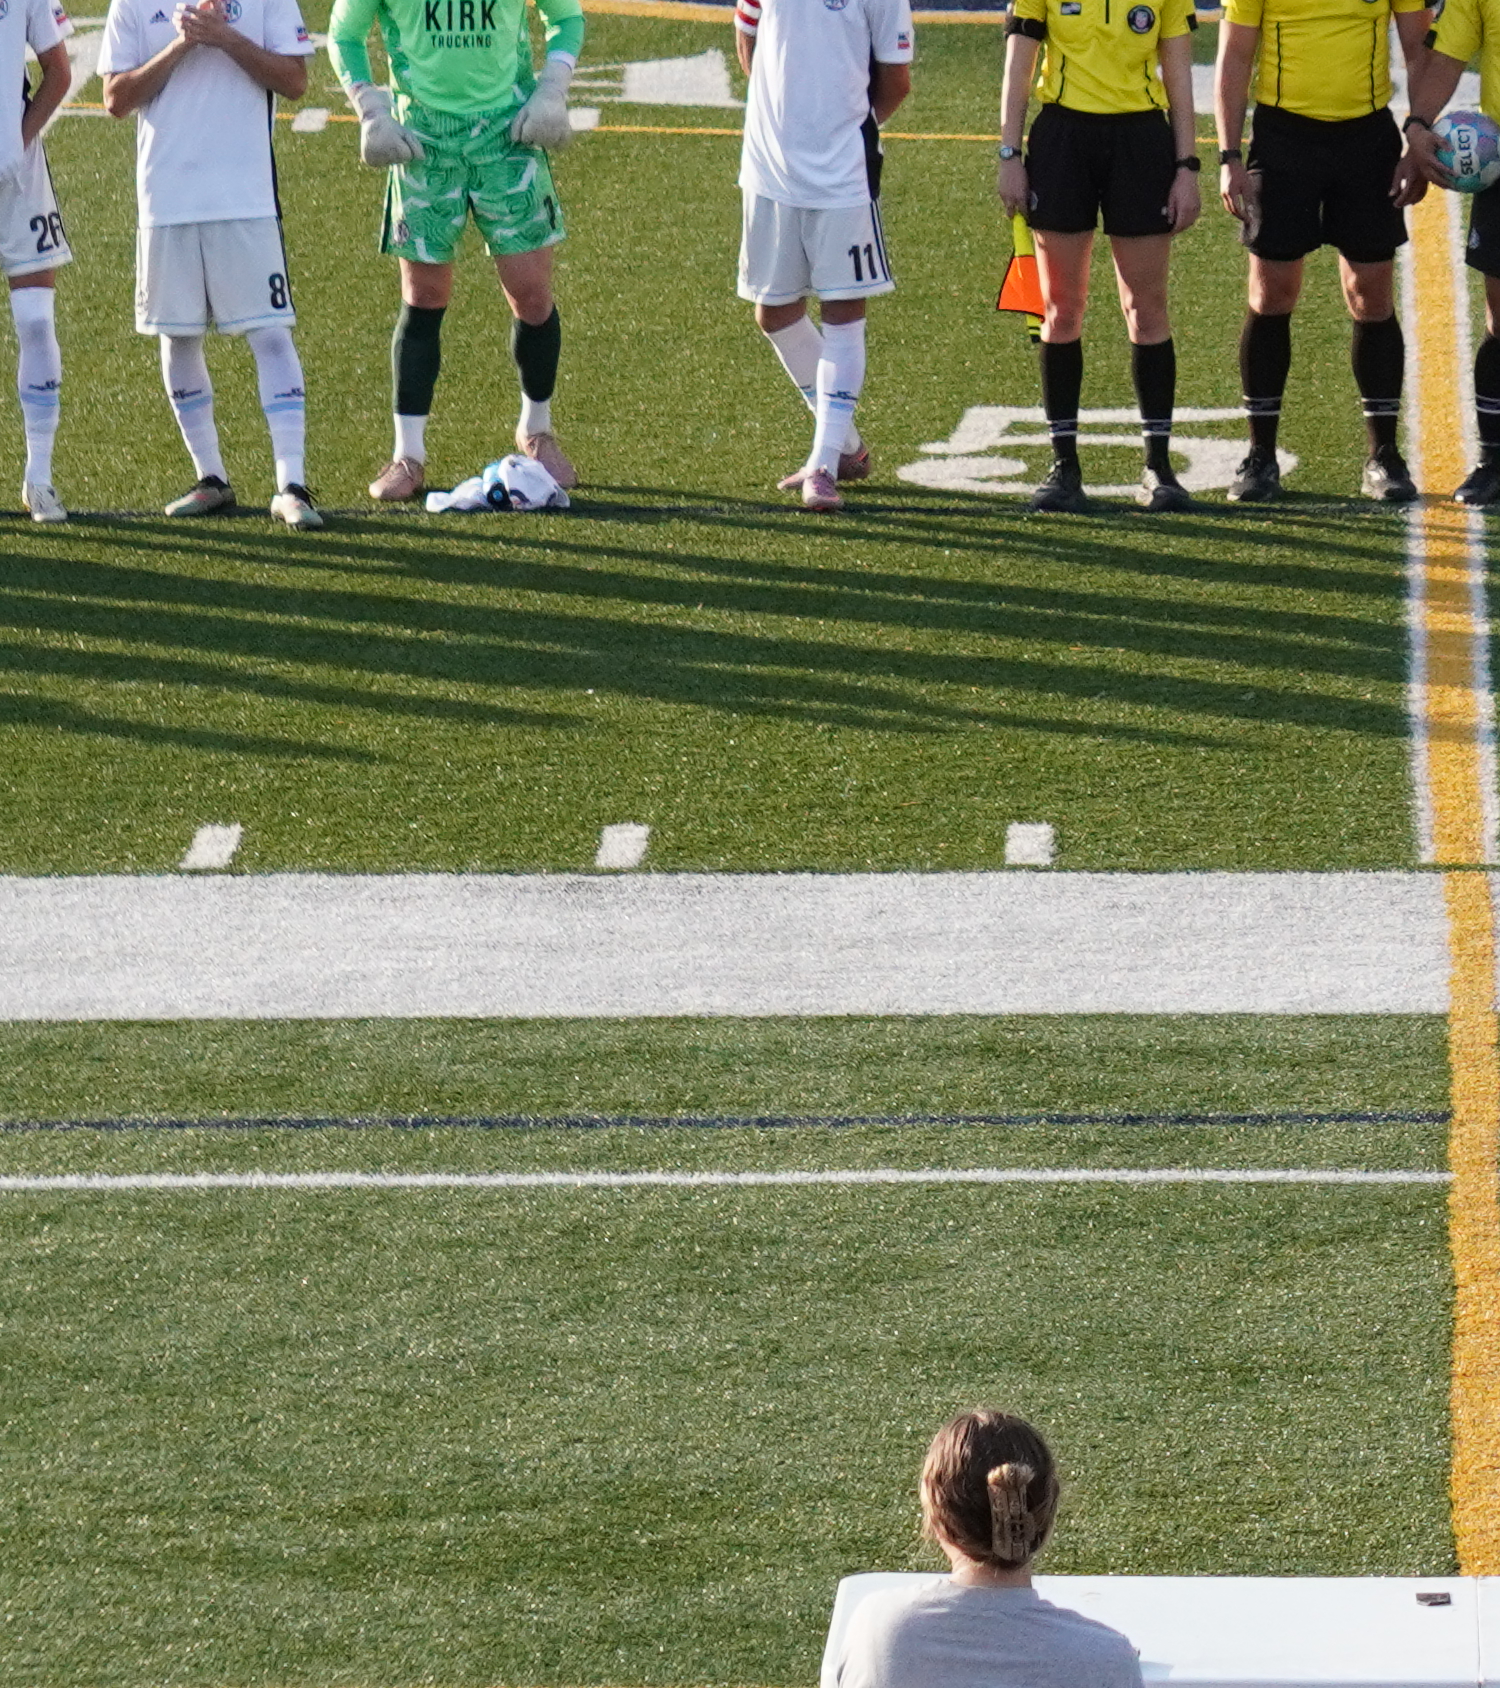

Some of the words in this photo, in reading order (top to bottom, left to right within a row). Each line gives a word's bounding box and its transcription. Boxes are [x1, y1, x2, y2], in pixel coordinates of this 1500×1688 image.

[430, 33, 493, 49] TRUCKING
[1456, 128, 1474, 176] SELECT
[29, 212, 62, 254] 26
[847, 243, 879, 283] 11
[267, 272, 288, 310] 8
